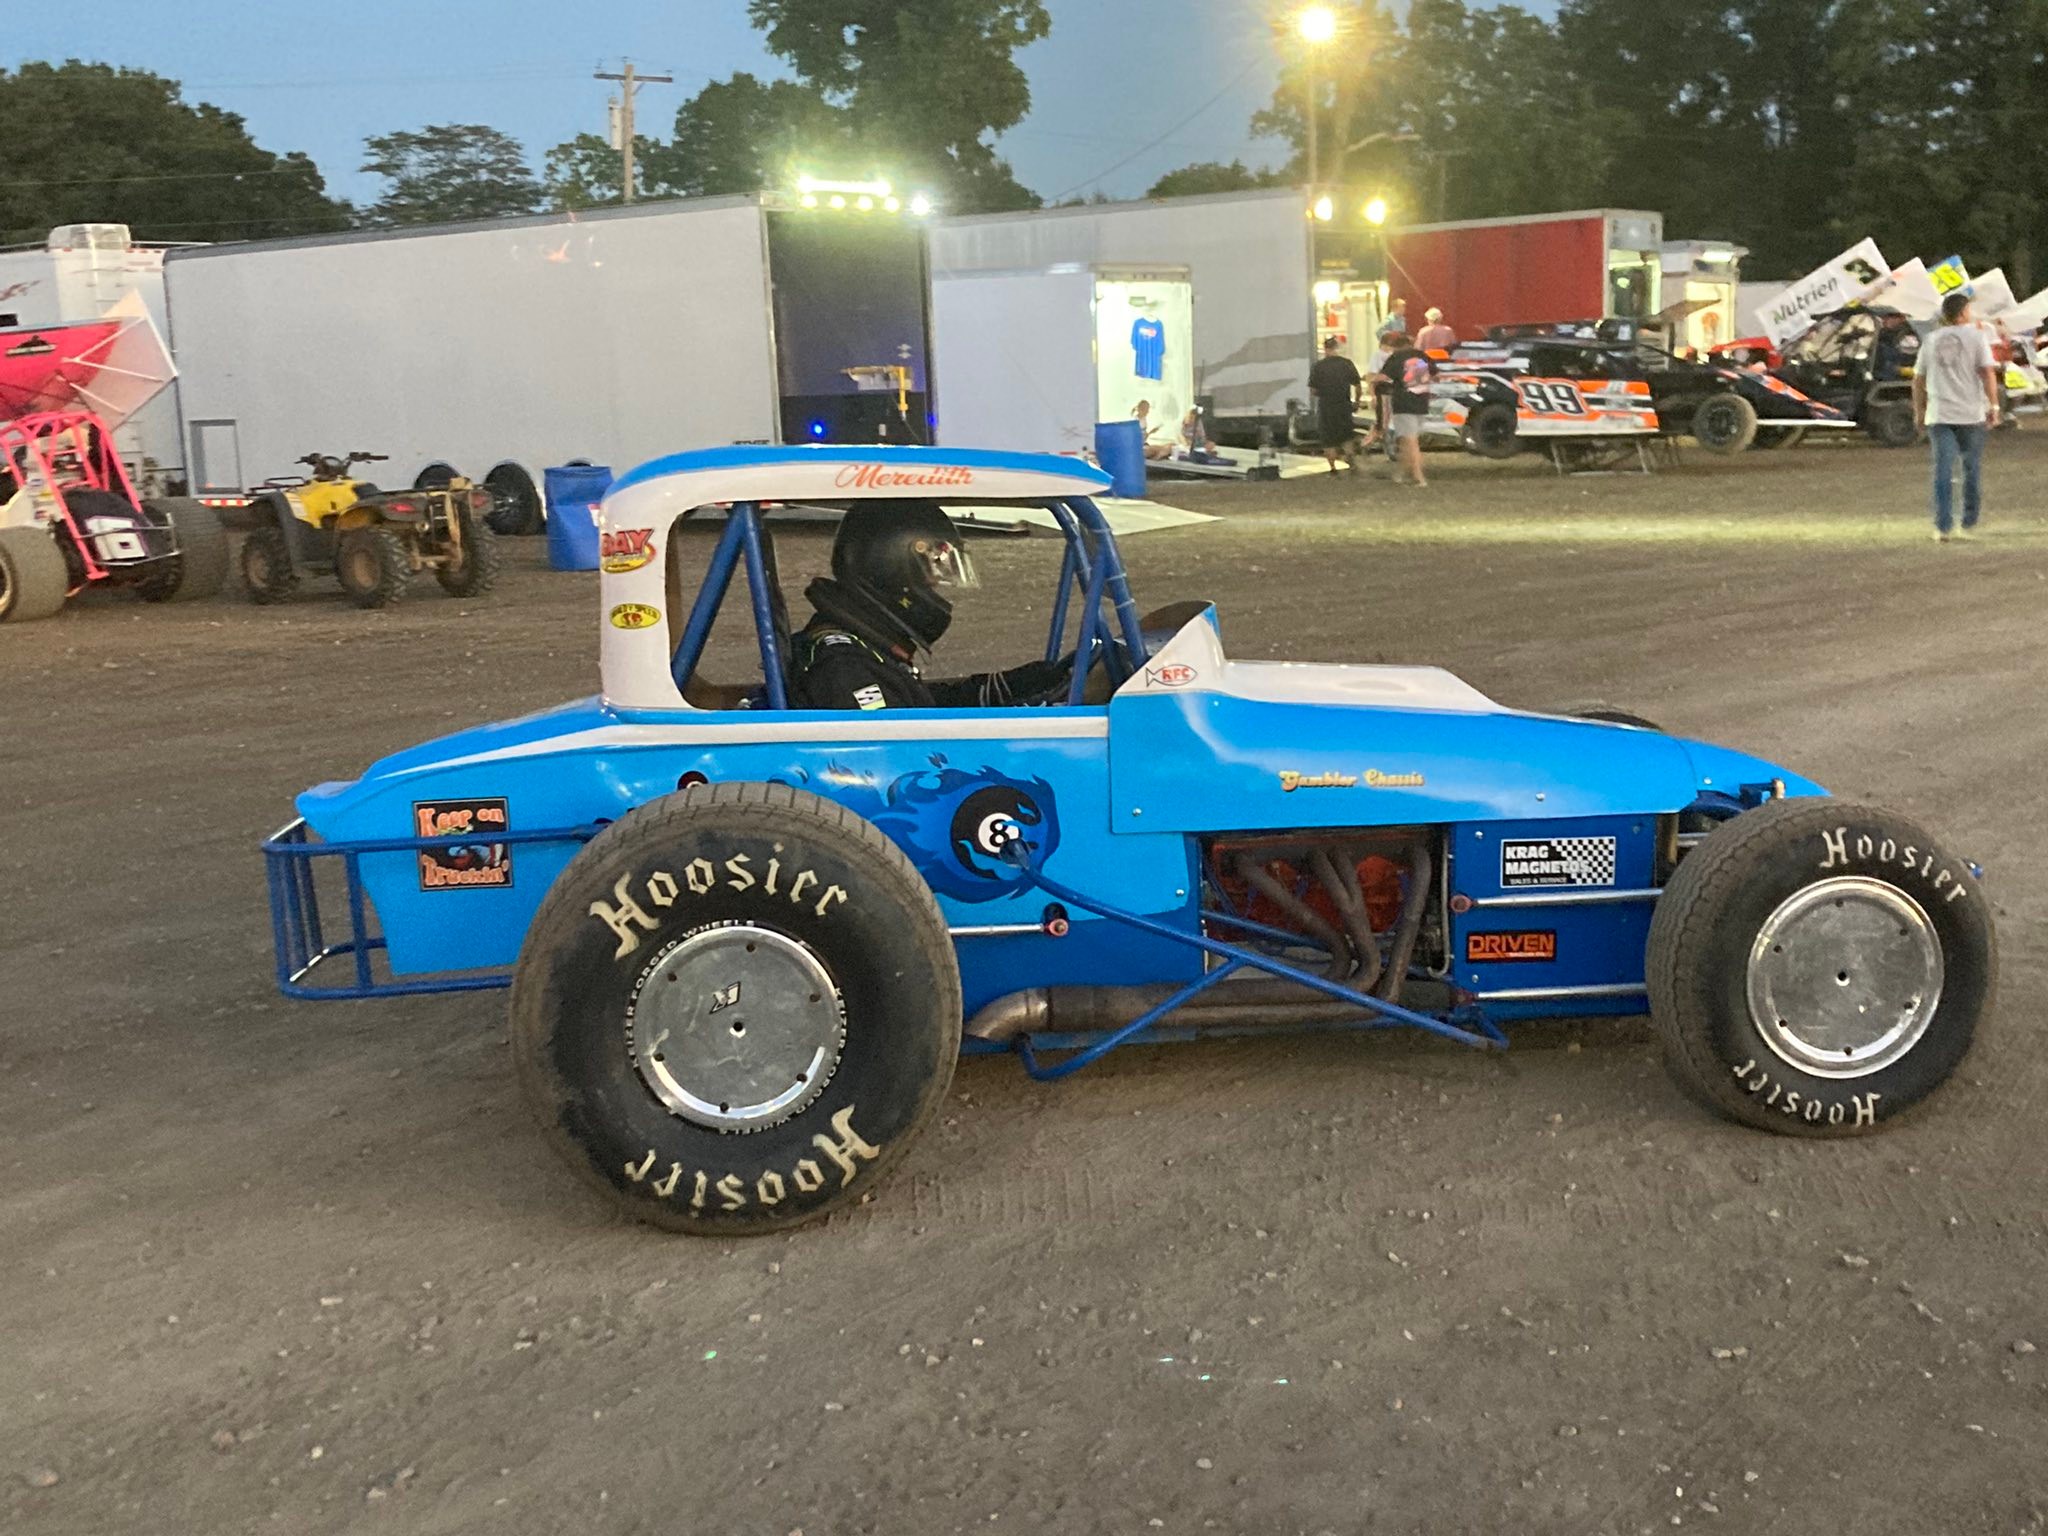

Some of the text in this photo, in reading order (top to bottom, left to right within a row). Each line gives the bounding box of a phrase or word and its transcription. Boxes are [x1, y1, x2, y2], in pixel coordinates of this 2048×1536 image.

[1771, 276, 1839, 325] Nutrien
[1518, 379, 1589, 415] 99
[834, 463, 973, 489] Meredith
[1162, 667, 1190, 682] RFC
[418, 808, 504, 837] Keep on
[989, 819, 1010, 848] 8
[1505, 846, 1549, 860] KRAG
[1505, 860, 1591, 875] MAGNETOS
[1819, 826, 1967, 902] Hoosier
[589, 842, 848, 961] Hoosier
[1468, 933, 1555, 953] DRIVEN
[631, 940, 678, 1000] FORGED
[682, 919, 755, 939] WHEELS
[1733, 1059, 1882, 1128] Hoosier
[624, 1103, 881, 1218] Hoosier
